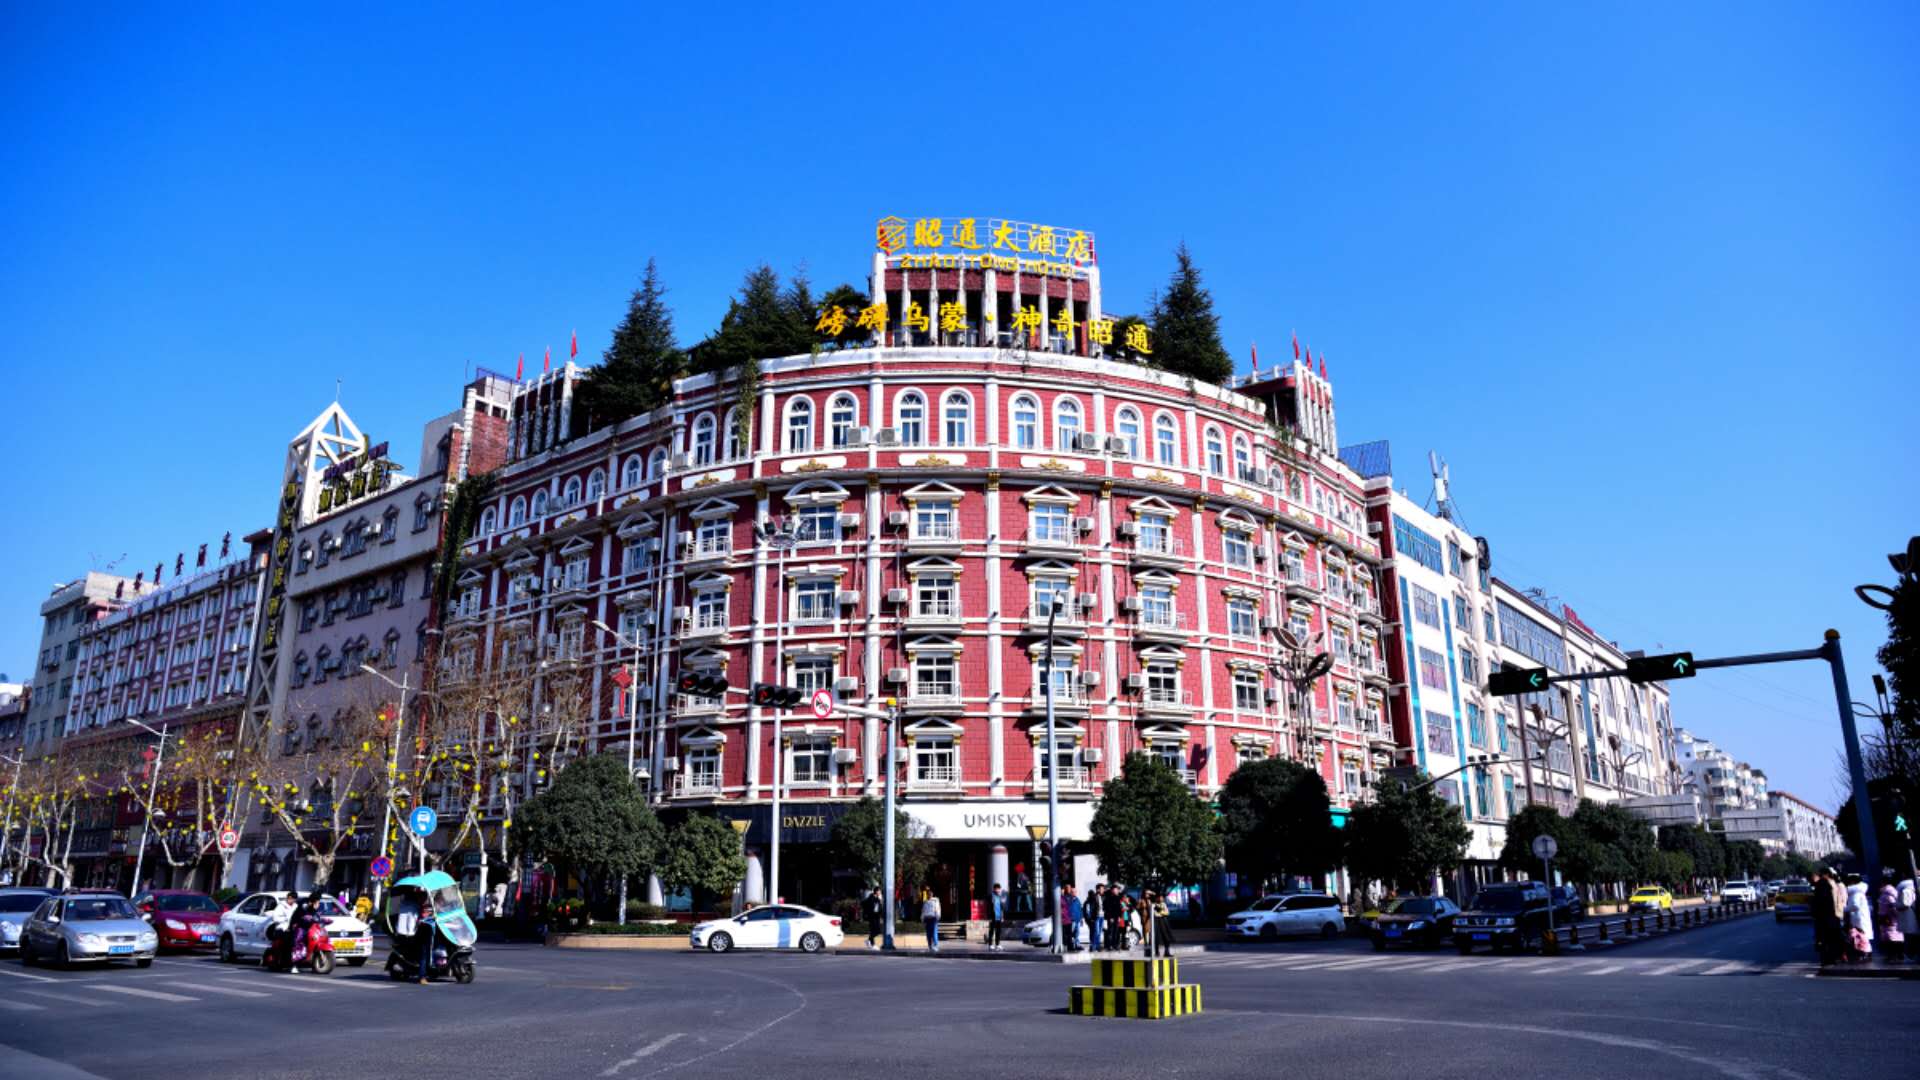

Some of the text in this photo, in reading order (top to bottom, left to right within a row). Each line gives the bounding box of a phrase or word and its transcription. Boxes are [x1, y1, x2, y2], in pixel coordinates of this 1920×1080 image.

[914, 218, 1091, 262] 昭通大酒店
[900, 254, 956, 269] ZHAO
[970, 253, 1019, 272] TONG
[783, 815, 826, 828] DAZZLE
[963, 813, 1027, 829] UMISKY
[224, 833, 235, 842] 40
